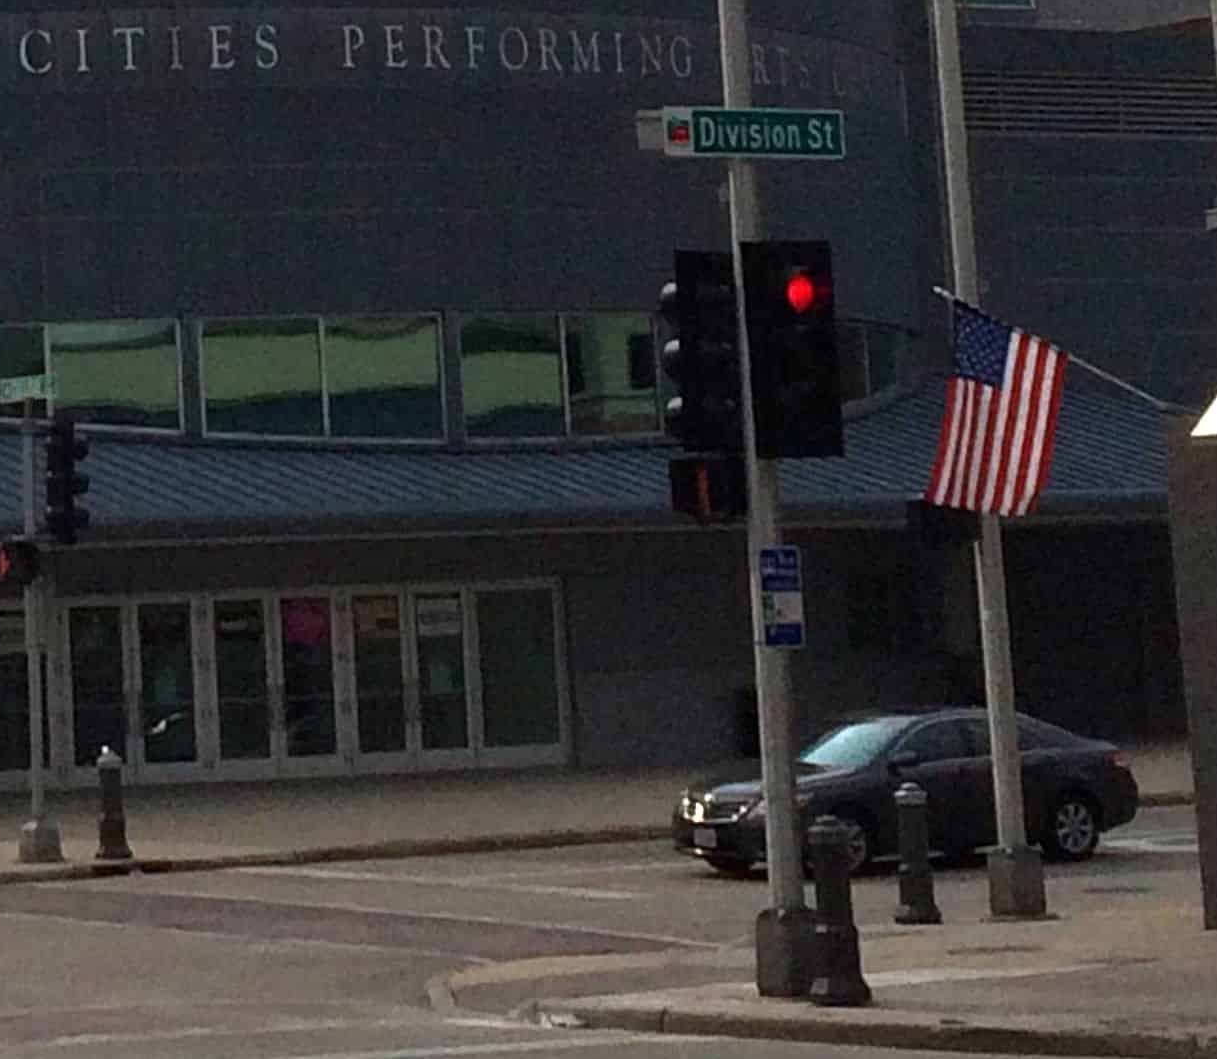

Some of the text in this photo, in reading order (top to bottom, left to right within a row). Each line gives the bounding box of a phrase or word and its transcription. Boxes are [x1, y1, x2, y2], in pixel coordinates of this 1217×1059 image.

[19, 22, 281, 74] CITIES
[341, 22, 695, 78] PERFORMING
[748, 41, 812, 89] RTS
[698, 116, 835, 150] Division St
